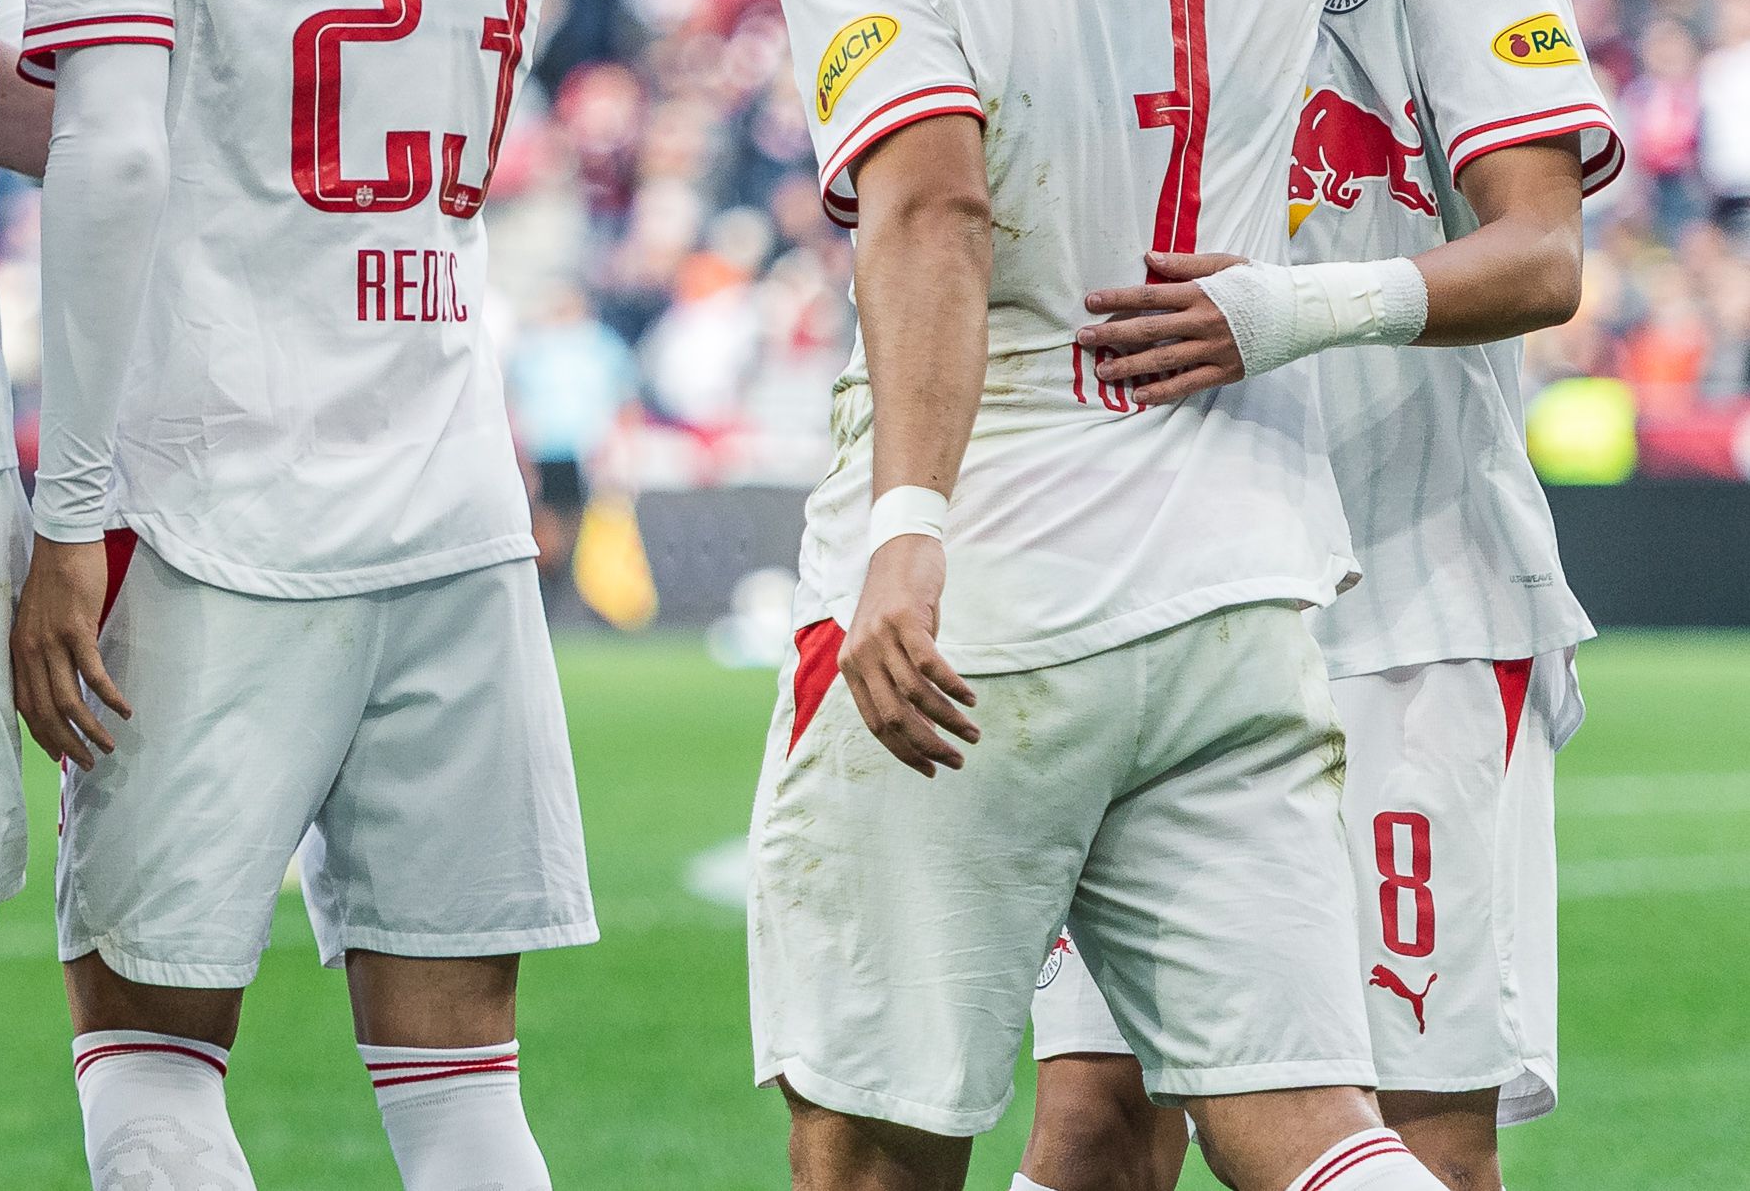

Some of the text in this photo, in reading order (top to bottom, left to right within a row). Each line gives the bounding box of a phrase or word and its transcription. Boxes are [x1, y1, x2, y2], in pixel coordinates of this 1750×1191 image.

[823, 22, 882, 97] RAUCH
[1531, 27, 1575, 54] RA
[1373, 811, 1435, 958] 8
